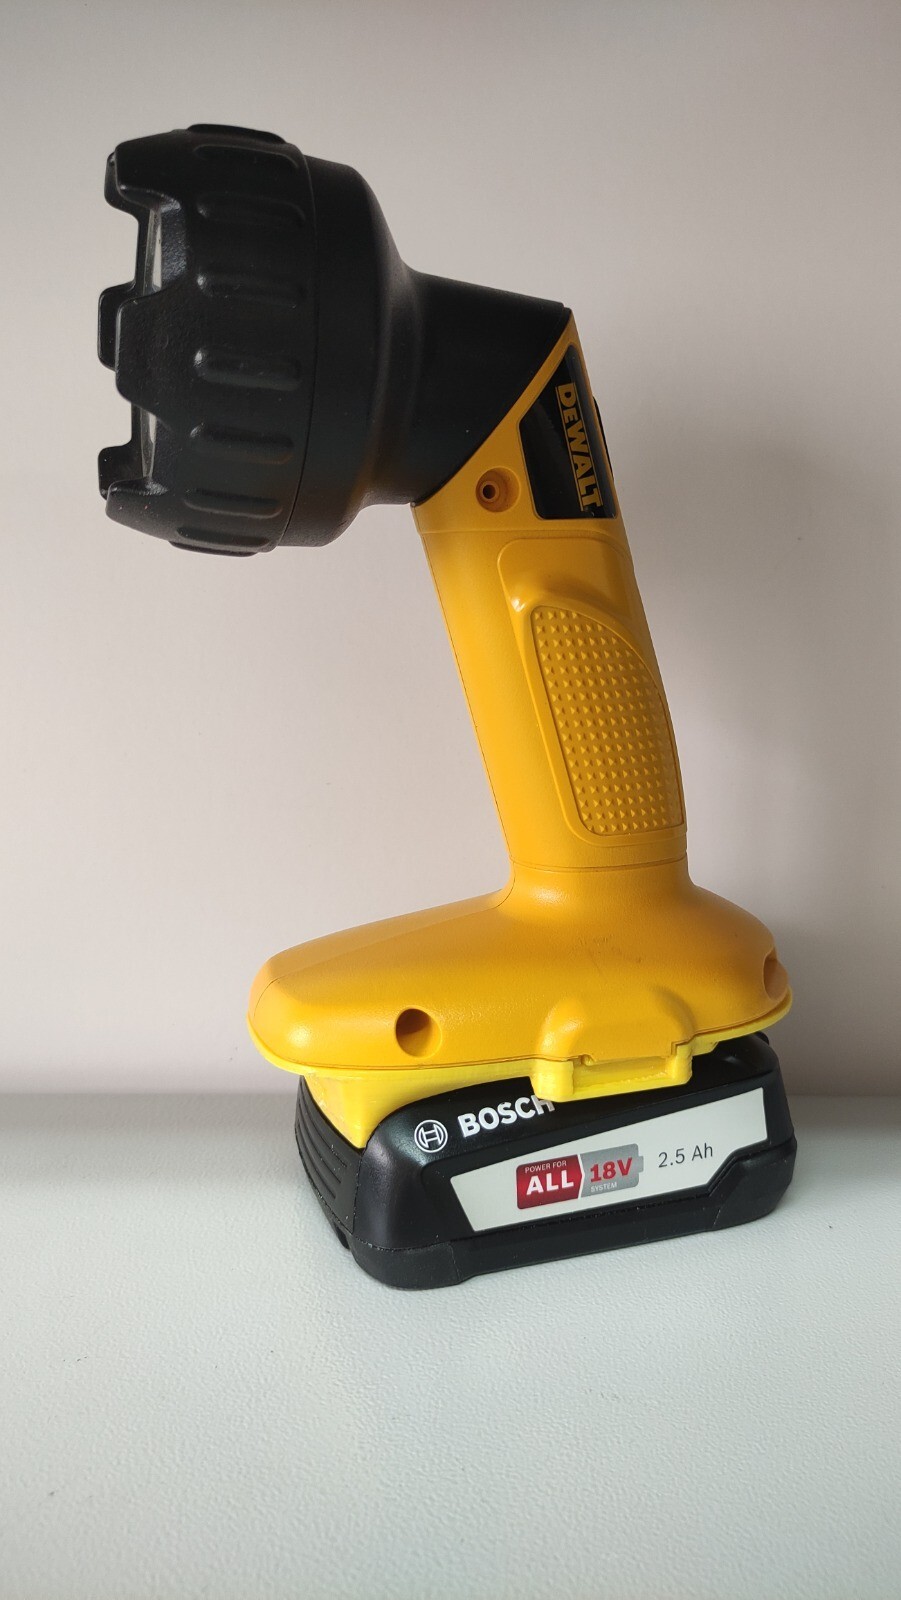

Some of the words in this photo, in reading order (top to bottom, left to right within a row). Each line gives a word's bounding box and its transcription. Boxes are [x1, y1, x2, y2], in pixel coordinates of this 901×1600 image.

[556, 382, 602, 508] DEWALT
[458, 1095, 555, 1138] BOSCH
[525, 1163, 551, 1174] POWER
[552, 1160, 567, 1169] FOR
[658, 1148, 685, 1168] 2.5
[691, 1142, 713, 1161] Ah
[526, 1170, 574, 1195] ALL
[590, 1157, 633, 1183] 18V
[590, 1181, 618, 1193] SYSTEM
